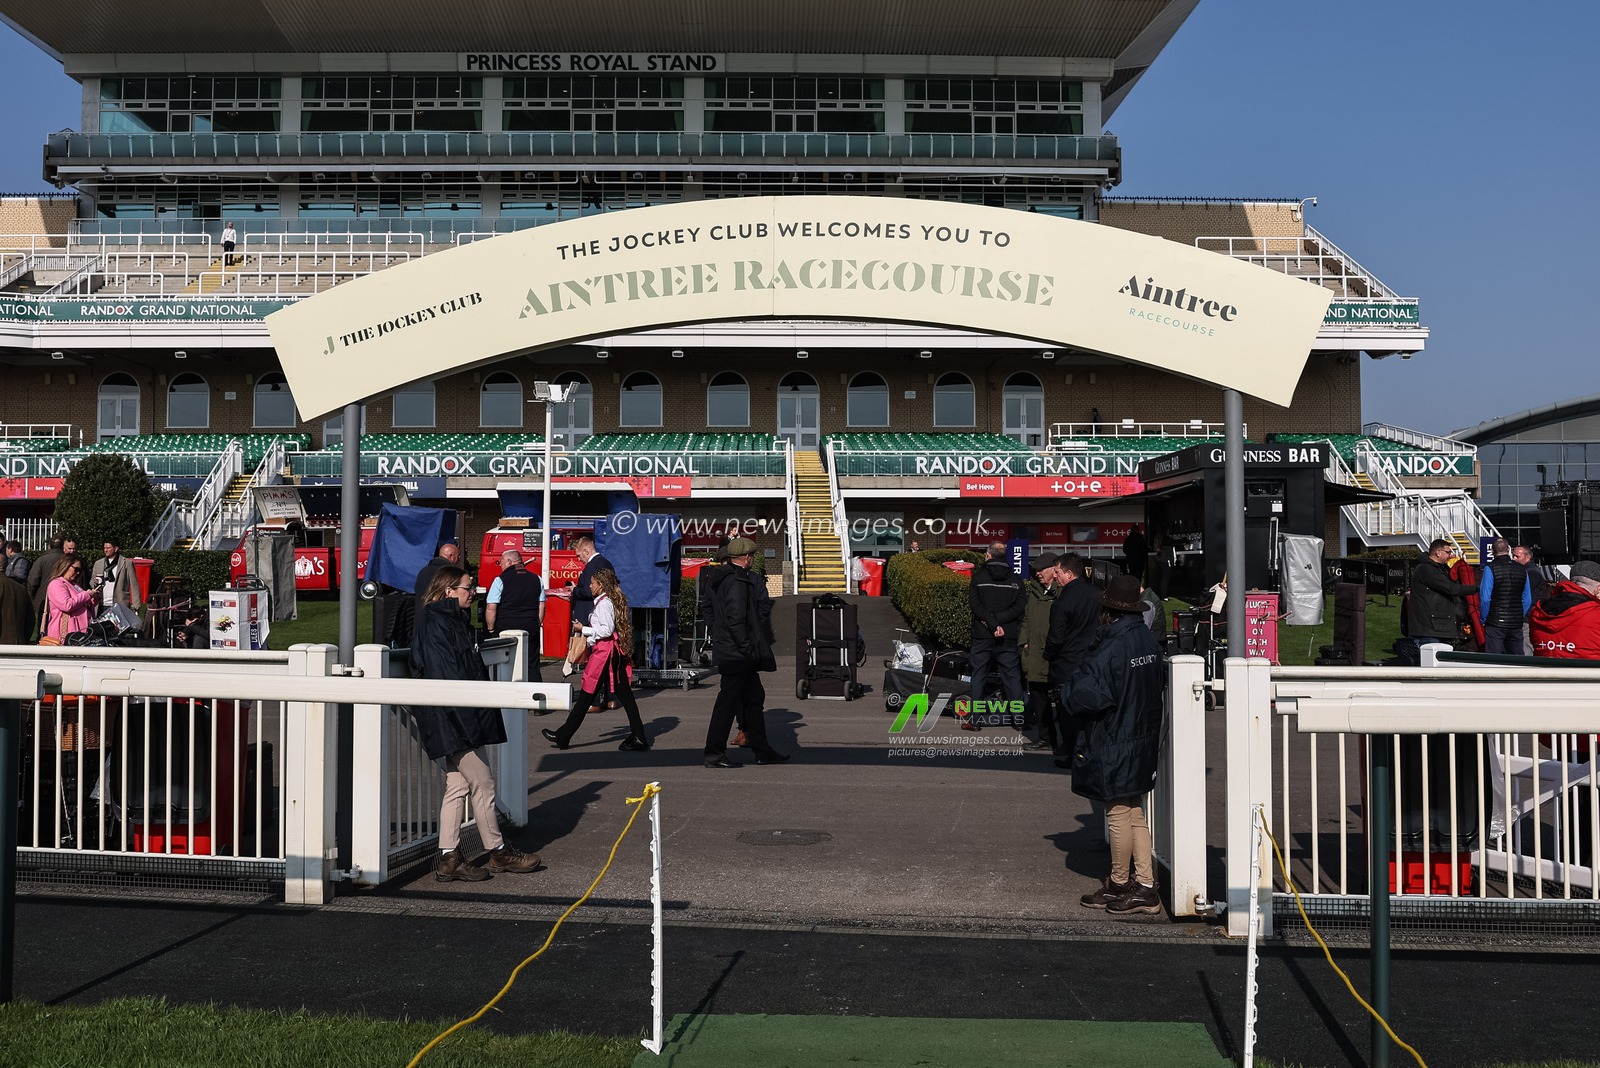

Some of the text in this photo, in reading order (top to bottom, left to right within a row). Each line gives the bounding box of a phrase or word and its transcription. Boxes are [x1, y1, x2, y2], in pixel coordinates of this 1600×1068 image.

[466, 54, 717, 71] PRINCESS ROYAL STAND
[557, 222, 1011, 260] THE JOCKEY CLUB WELCOMES YOU TO
[518, 259, 1054, 319] AINTREE RACECOURSE
[1118, 275, 1238, 322] Aintree
[80, 305, 256, 316] RANDOX GRAND NATIONAL
[339, 327, 375, 347] THE
[376, 305, 437, 337] JOCKEY
[439, 292, 483, 314] CLUB
[1351, 308, 1413, 319] NATIONAL
[1129, 307, 1215, 337] RACECOURSE
[1210, 448, 1320, 463] GNNESS BAR
[377, 456, 700, 475] RANDOX GRAND NATIONAL
[915, 456, 1013, 475] RANDOX
[1025, 456, 1107, 475] GRAND
[966, 483, 995, 491] Bet Here
[1130, 654, 1157, 668] SECURTY
